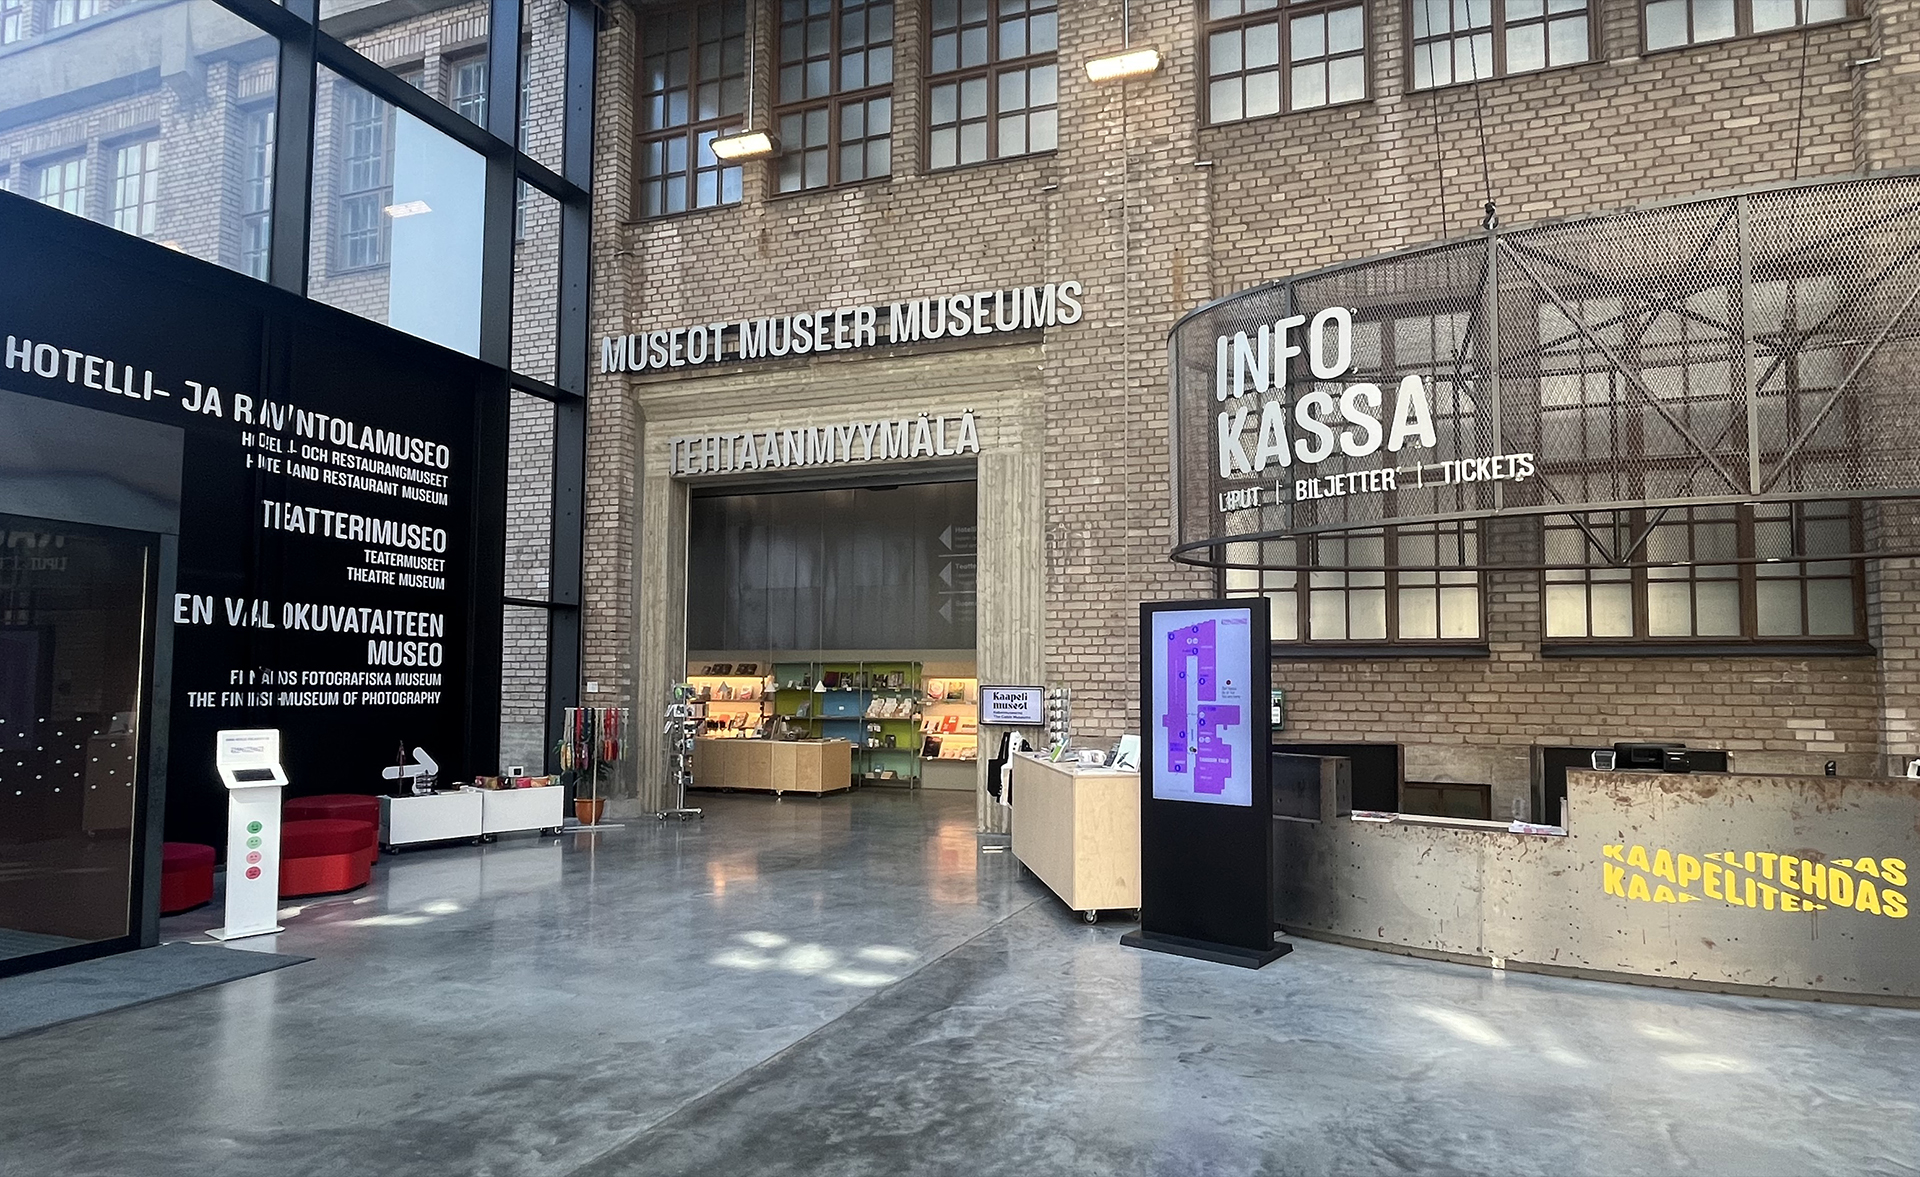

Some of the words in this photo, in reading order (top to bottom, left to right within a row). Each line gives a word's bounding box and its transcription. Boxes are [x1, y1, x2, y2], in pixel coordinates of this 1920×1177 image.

[601, 322, 728, 374] MUSEOT
[739, 306, 876, 360] MUSEER
[890, 280, 1083, 344] MUSEUMS
[1217, 306, 1353, 401] INFO
[5, 335, 170, 401] HOTELLI-
[182, 380, 222, 417] JA
[668, 407, 981, 475] TEHTAANMYYMÄLÄ
[1217, 375, 1437, 479] KASSA
[292, 463, 319, 481] AND
[323, 469, 398, 497] RESTAURANT
[402, 485, 448, 506] MUSEUM
[301, 444, 328, 463] OCH
[332, 451, 448, 488] RESTAURANGMUSEET
[1219, 486, 1264, 512] LIPUT
[1296, 471, 1397, 501] BILJETTER
[1440, 453, 1535, 485] TICKETS
[264, 500, 447, 553] TEATTERIMUSEO
[347, 567, 395, 585] THEATRE
[399, 573, 445, 590] MUSEUM
[364, 549, 445, 572] TEATERMUSEET
[368, 640, 443, 667] MUSEO
[187, 692, 216, 707] THE
[280, 692, 339, 706] MUSEUM
[343, 692, 358, 705] OF
[362, 691, 441, 705] PHOTOGRAPHY
[302, 671, 391, 686] FOTOGRAFISKA
[395, 672, 441, 686] MUSEUM
[993, 691, 1028, 702] Kaapeli
[993, 702, 1028, 710] museot
